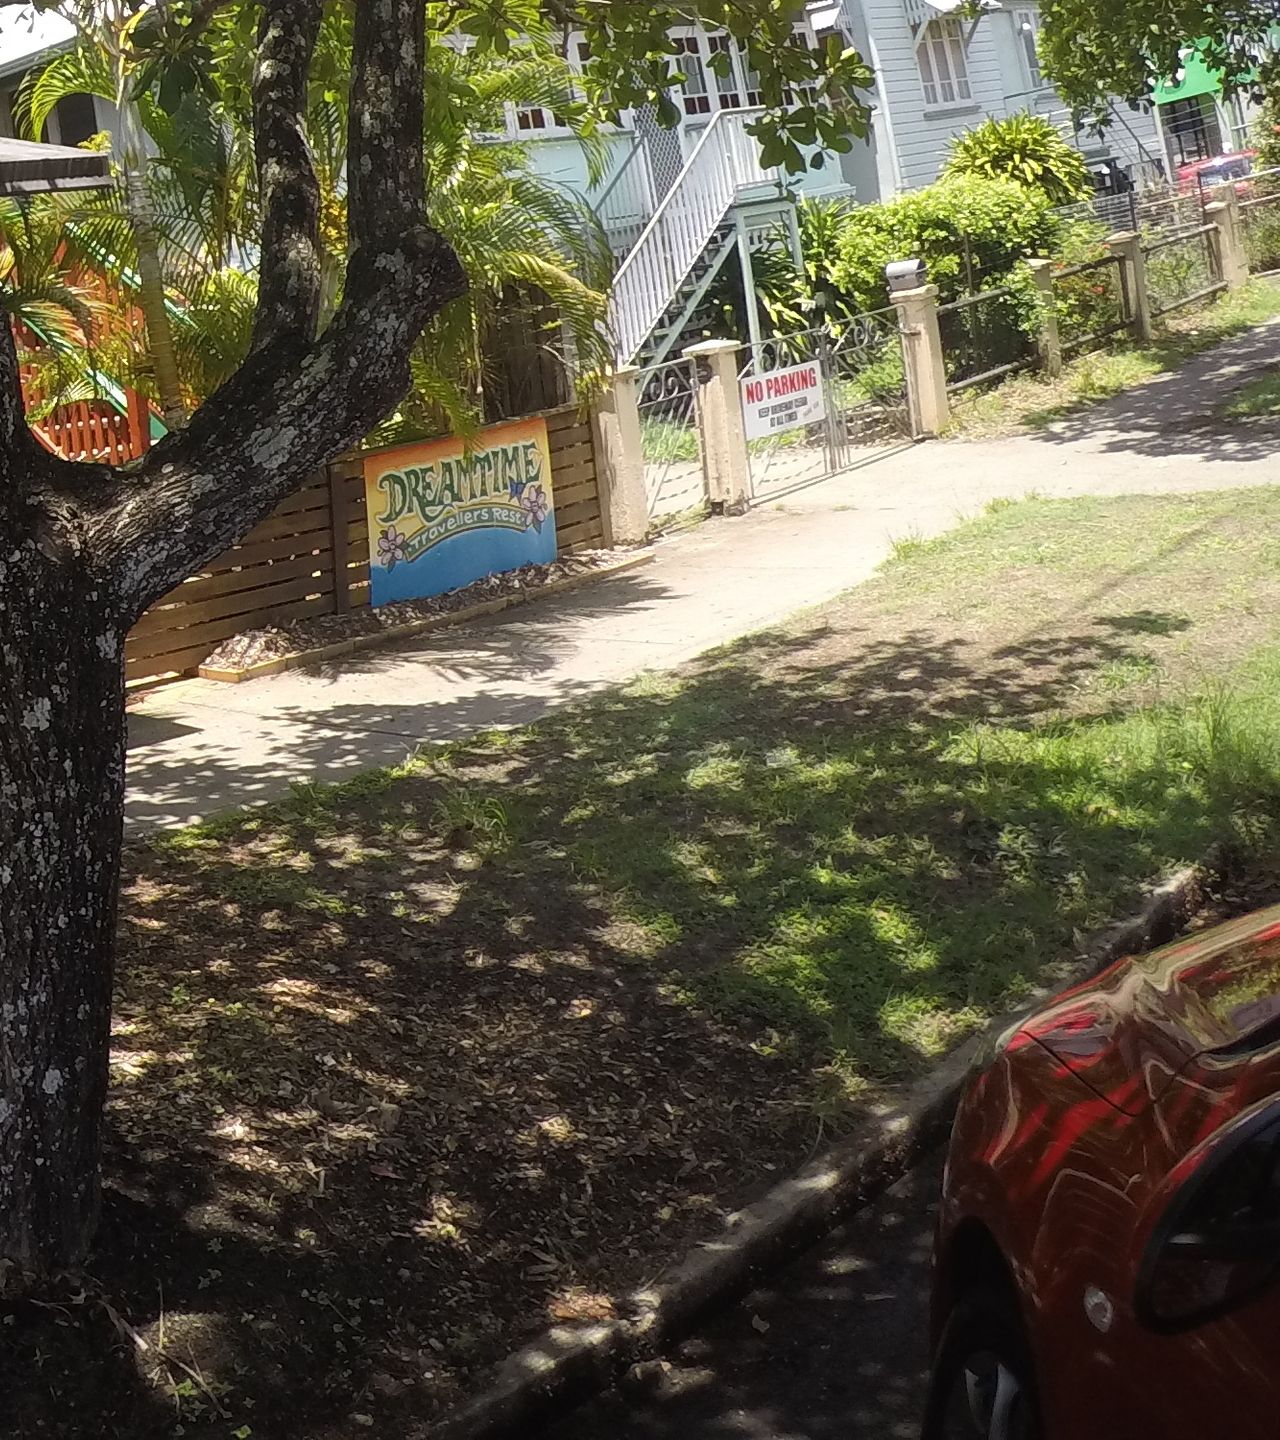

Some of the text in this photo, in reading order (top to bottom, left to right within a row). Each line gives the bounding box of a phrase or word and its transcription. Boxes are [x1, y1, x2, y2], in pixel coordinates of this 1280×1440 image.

[745, 367, 817, 405] NO PARKING
[377, 440, 543, 524] DREAMTIME
[409, 507, 521, 550] Travellers Rest
